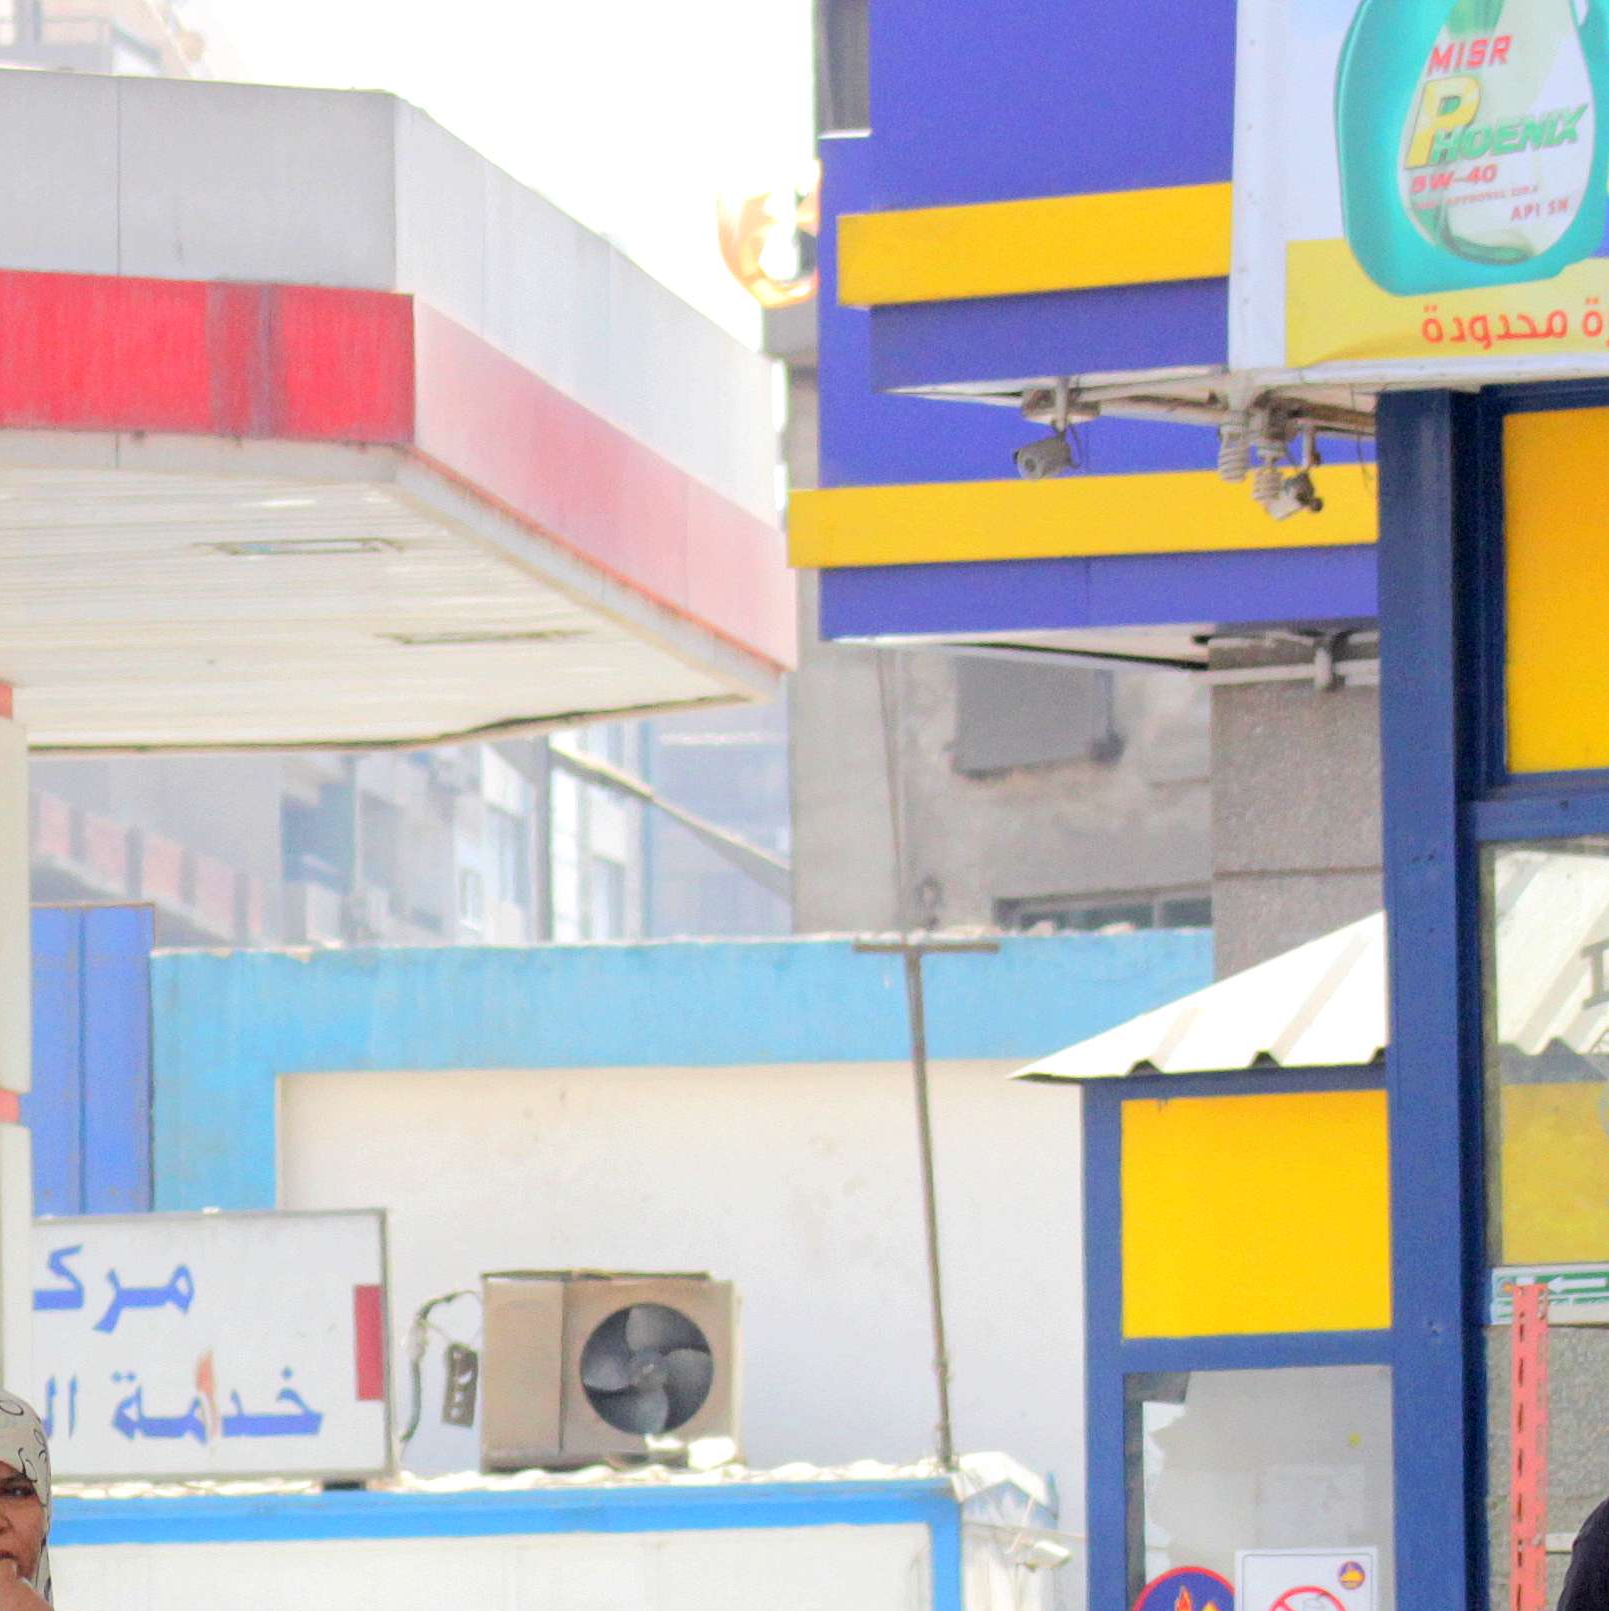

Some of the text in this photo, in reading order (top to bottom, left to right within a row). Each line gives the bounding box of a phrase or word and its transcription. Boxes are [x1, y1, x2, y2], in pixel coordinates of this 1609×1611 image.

[1427, 35, 1511, 74] MISR
[1404, 74, 1589, 170] PHOENIX
[1421, 304, 1569, 350] محدودة
[32, 1244, 194, 1334] مرك
[111, 1366, 324, 1446] خدمة
